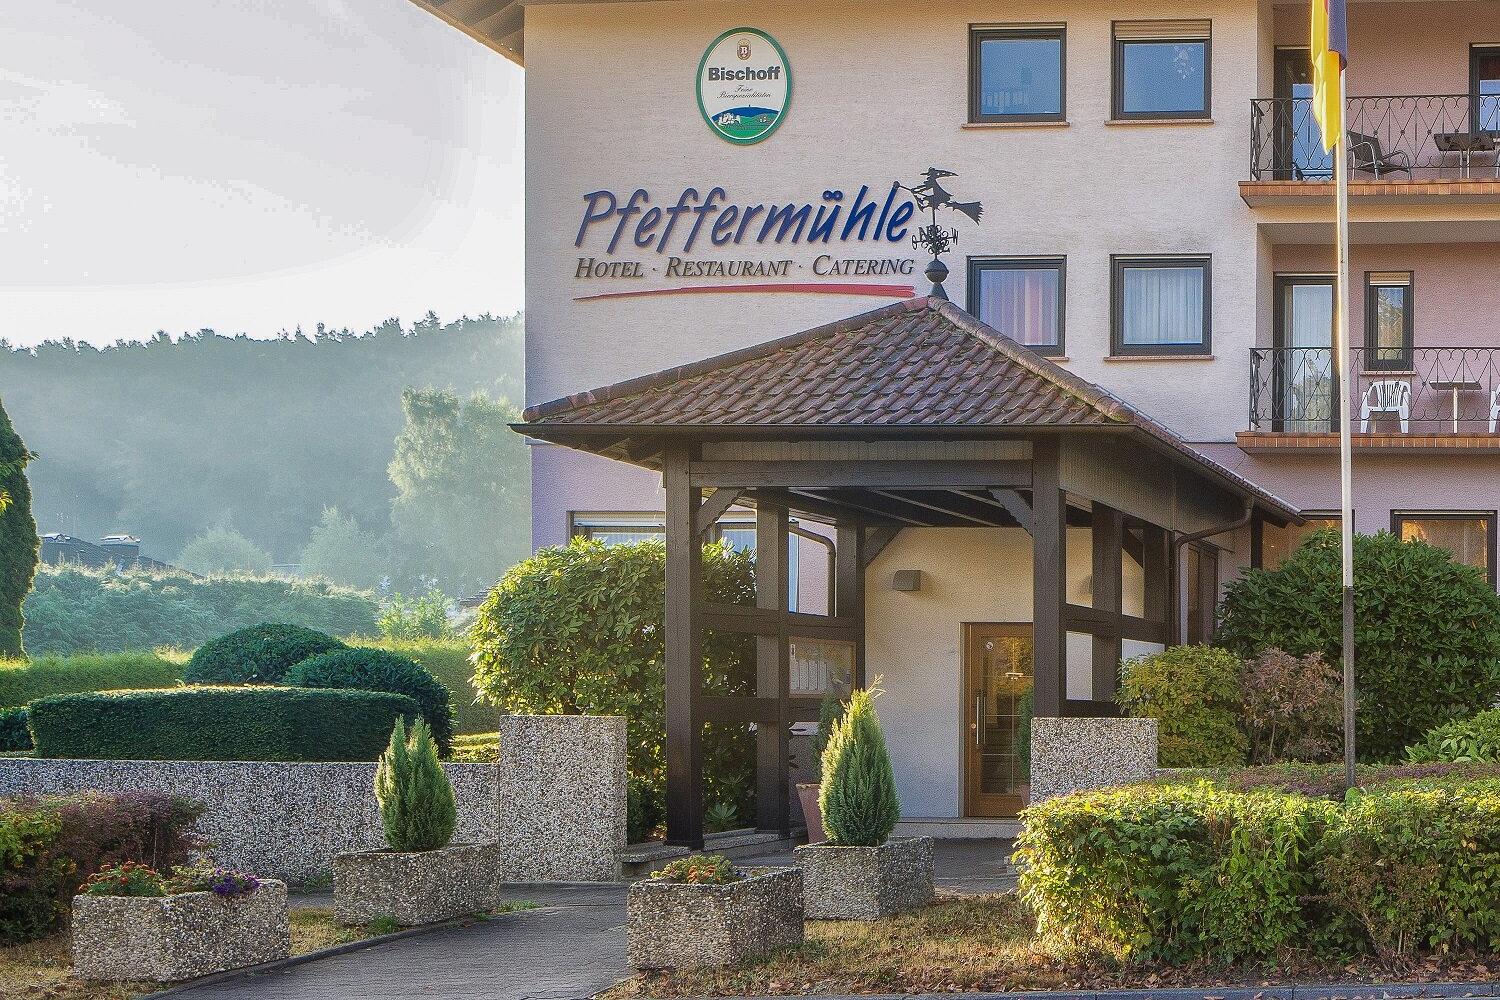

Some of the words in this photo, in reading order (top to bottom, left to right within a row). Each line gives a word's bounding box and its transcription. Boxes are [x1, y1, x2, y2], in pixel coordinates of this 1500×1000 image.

[708, 66, 781, 81] Bischoff
[574, 185, 915, 254] Pfeffermühle
[574, 258, 644, 278] HOTEL
[664, 256, 793, 277] RESTAURANT
[812, 254, 915, 276] CATERING
